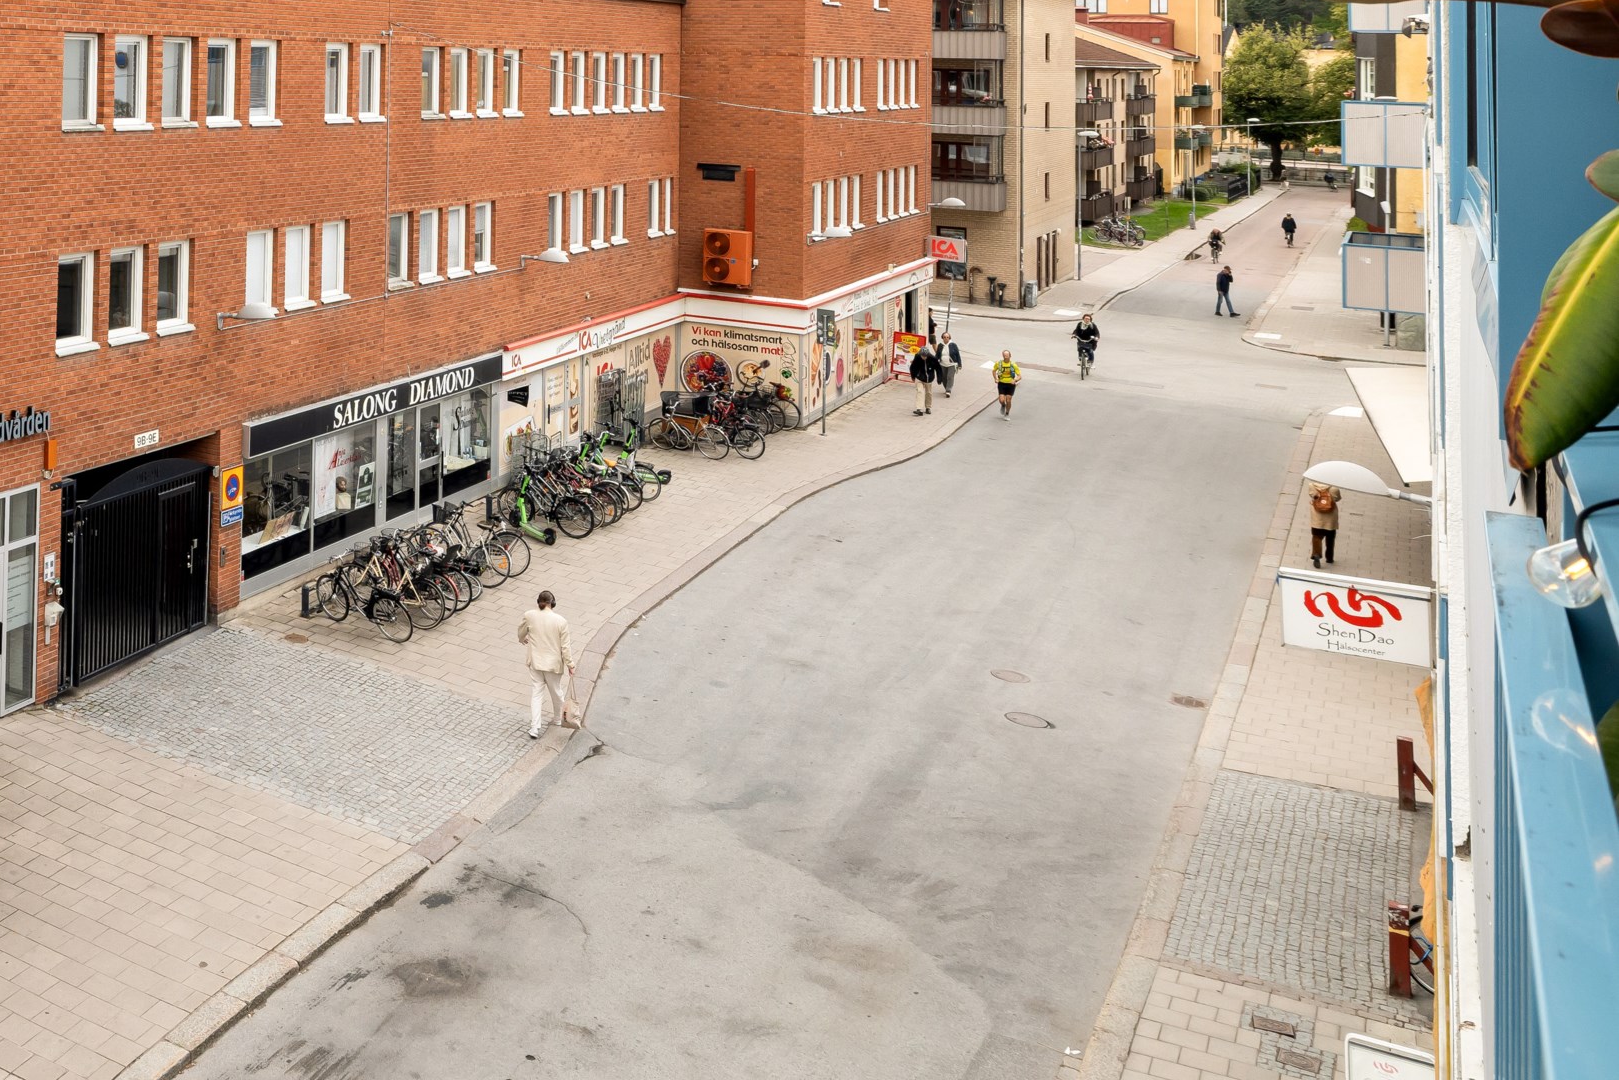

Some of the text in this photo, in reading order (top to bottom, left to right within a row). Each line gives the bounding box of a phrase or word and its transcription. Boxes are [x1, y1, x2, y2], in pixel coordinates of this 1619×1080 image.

[932, 238, 958, 256] ICA
[578, 330, 592, 351] ICA
[691, 326, 783, 344] Vi kan klimatsmart
[628, 338, 651, 373] Alltid
[691, 338, 784, 356] och hälsosam mat!
[511, 354, 522, 368] ICA
[333, 366, 475, 429] SALONG DIAMOND
[137, 432, 157, 446] 9B-9E
